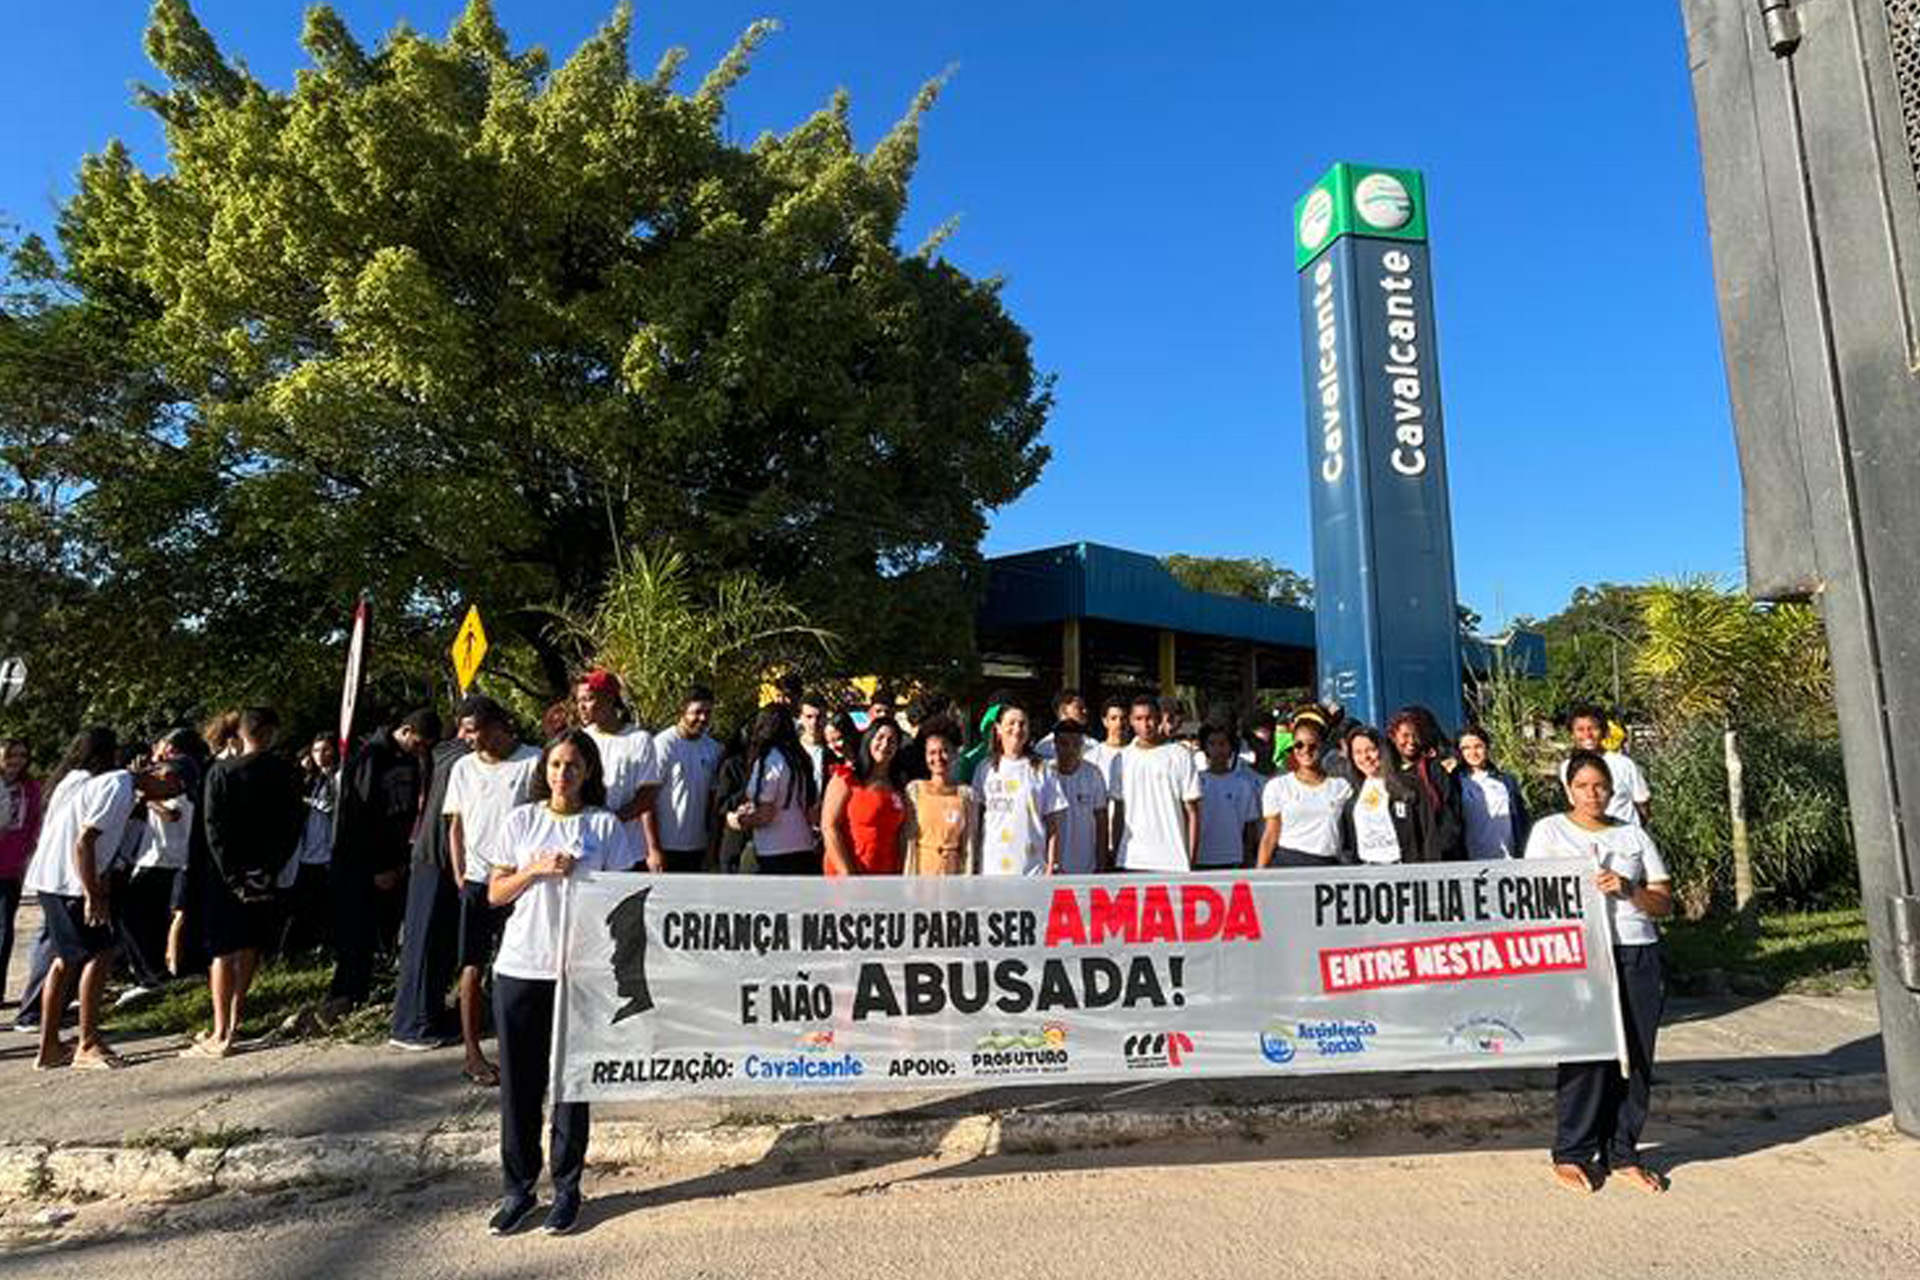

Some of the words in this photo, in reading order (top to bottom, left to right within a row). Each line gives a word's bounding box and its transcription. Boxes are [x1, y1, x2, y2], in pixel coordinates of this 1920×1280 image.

[1313, 260, 1344, 484] Cavalcante
[1380, 249, 1426, 477] Cavalcante
[662, 911, 790, 957] CRIANÇA
[801, 911, 906, 951] NASCEU
[912, 911, 981, 948] PARA
[987, 911, 1037, 948] SER
[1044, 882, 1262, 948] AMADA
[1314, 878, 1466, 927] PEDOFILIA
[1474, 868, 1490, 921] É
[1498, 876, 1585, 920] CRIME!
[1328, 950, 1411, 988] ENTRE
[1413, 937, 1503, 978] NESTA
[1506, 930, 1582, 969] LUTA!
[741, 984, 760, 1024] E
[770, 971, 834, 1023] NÃO
[851, 954, 1187, 1022] ABUSADA!
[592, 1052, 734, 1084] REALIZAÇÃO:
[744, 1054, 864, 1079] Cavalcante
[888, 1058, 957, 1077] APOIO:
[971, 1050, 1069, 1068] PROFUTURO
[1317, 1036, 1365, 1056] Social
